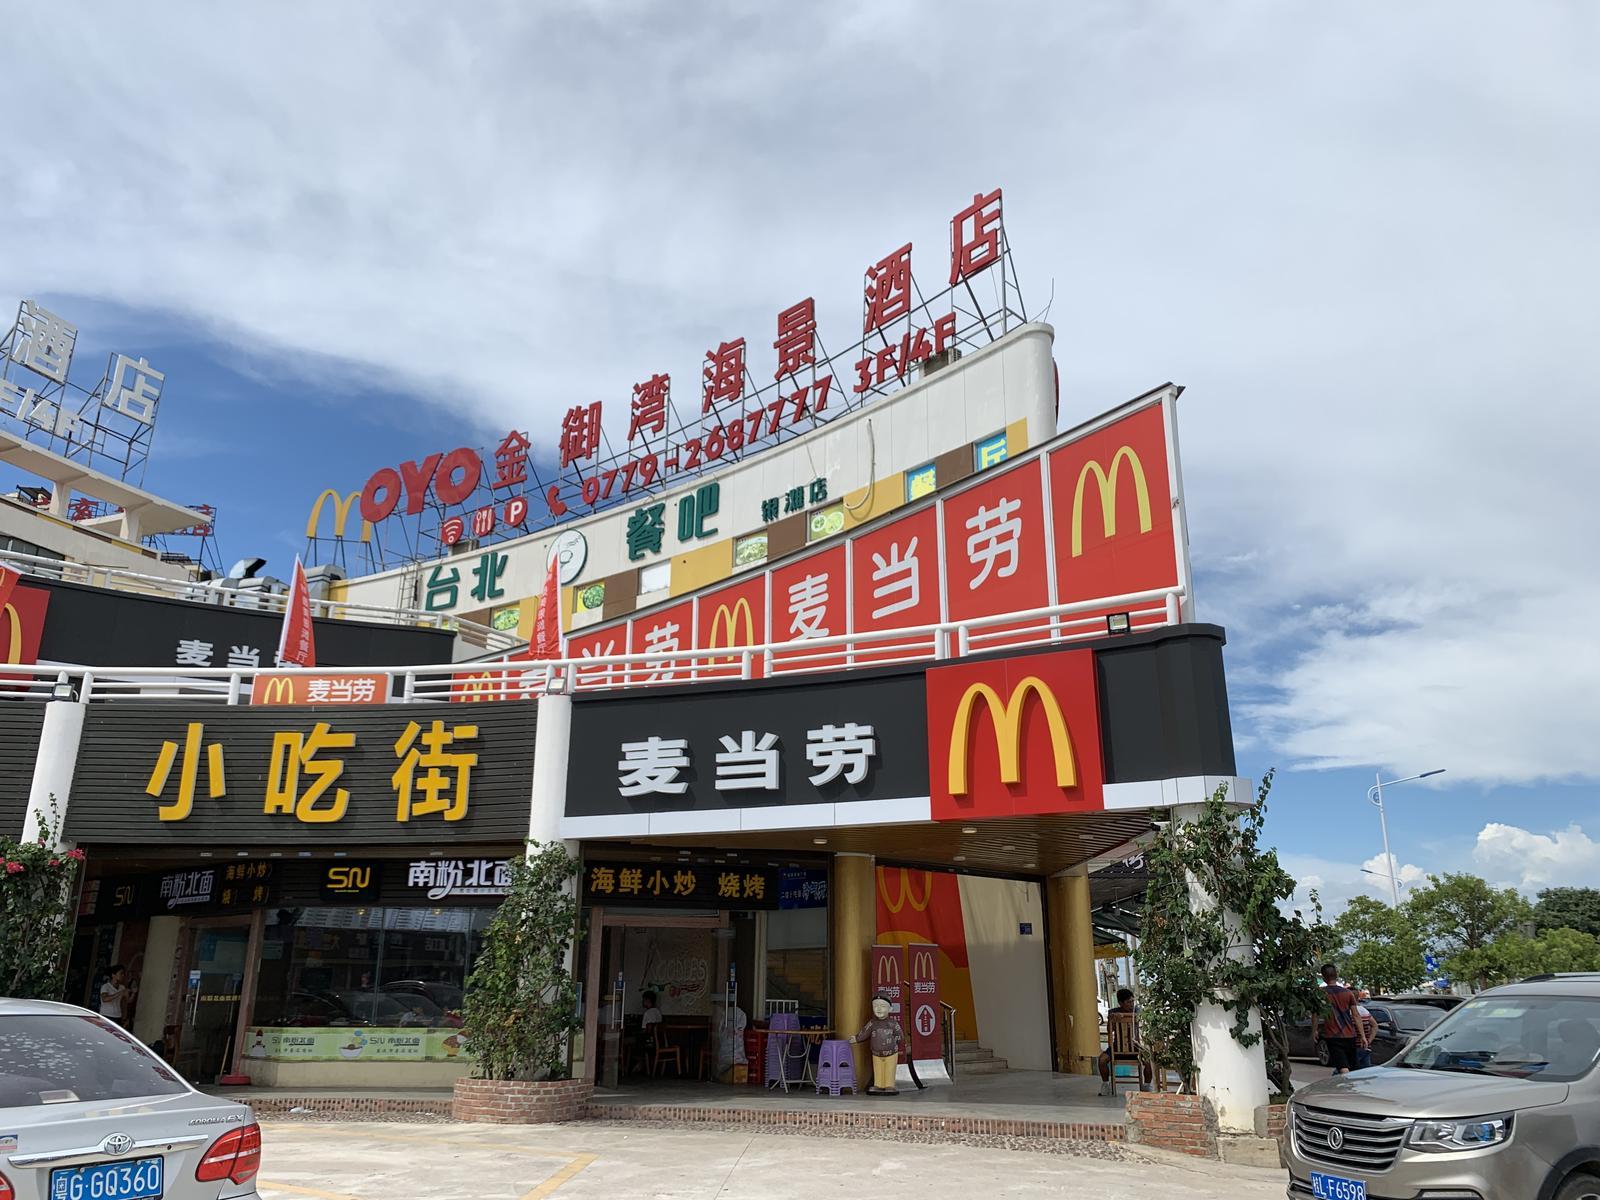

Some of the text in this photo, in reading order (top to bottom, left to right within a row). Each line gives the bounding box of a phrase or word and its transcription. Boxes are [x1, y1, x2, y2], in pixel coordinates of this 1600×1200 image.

[853, 312, 956, 394] 3F/4F
[582, 374, 833, 505] 0779-2687777
[360, 447, 481, 523] OYO
[787, 497, 1022, 642] 麦当劳
[307, 679, 375, 702] 麦当劳
[145, 720, 480, 824] 小吃街
[617, 721, 876, 798] 麦当劳
[590, 867, 767, 900] 海鲜小炒 烧烤
[914, 982, 935, 994] 麦当劳
